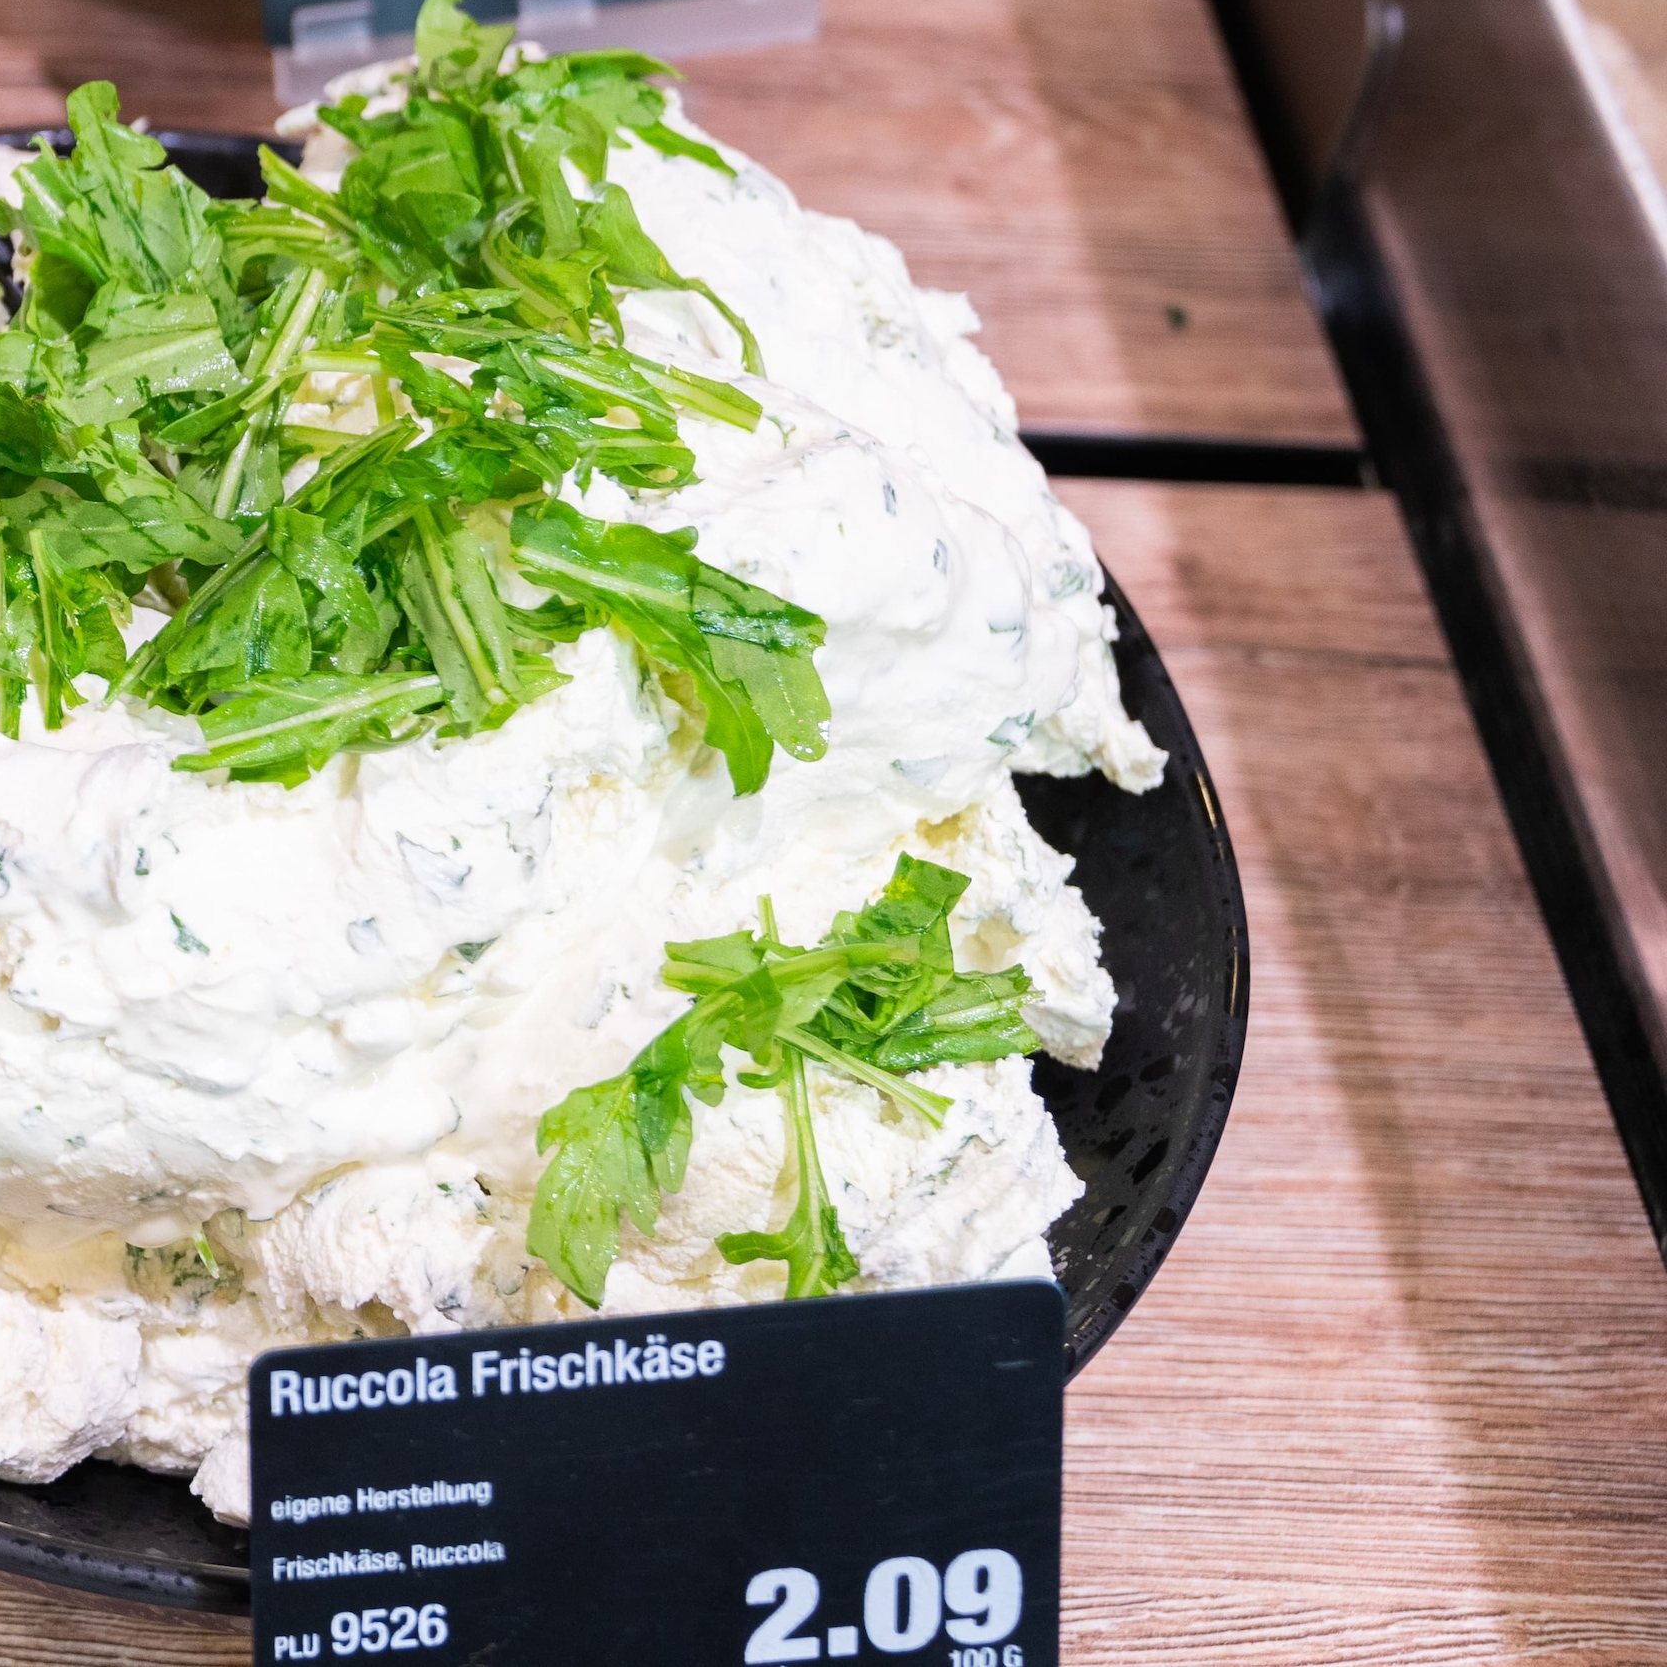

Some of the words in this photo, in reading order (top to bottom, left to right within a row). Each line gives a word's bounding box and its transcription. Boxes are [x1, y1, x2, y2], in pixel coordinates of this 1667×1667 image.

[269, 1356, 459, 1417] Ruccola
[471, 1334, 726, 1397] Frischkäse
[270, 1493, 352, 1524] eigene
[356, 1479, 494, 1514] Herstellung
[272, 1547, 407, 1582] Frischkäse,
[411, 1539, 507, 1570] Ruccola
[744, 1547, 1023, 1665] 2.09
[274, 1633, 321, 1661] PLU
[330, 1603, 449, 1657] 9526
[948, 1646, 997, 1667] 100
[1002, 1644, 1024, 1667] G
